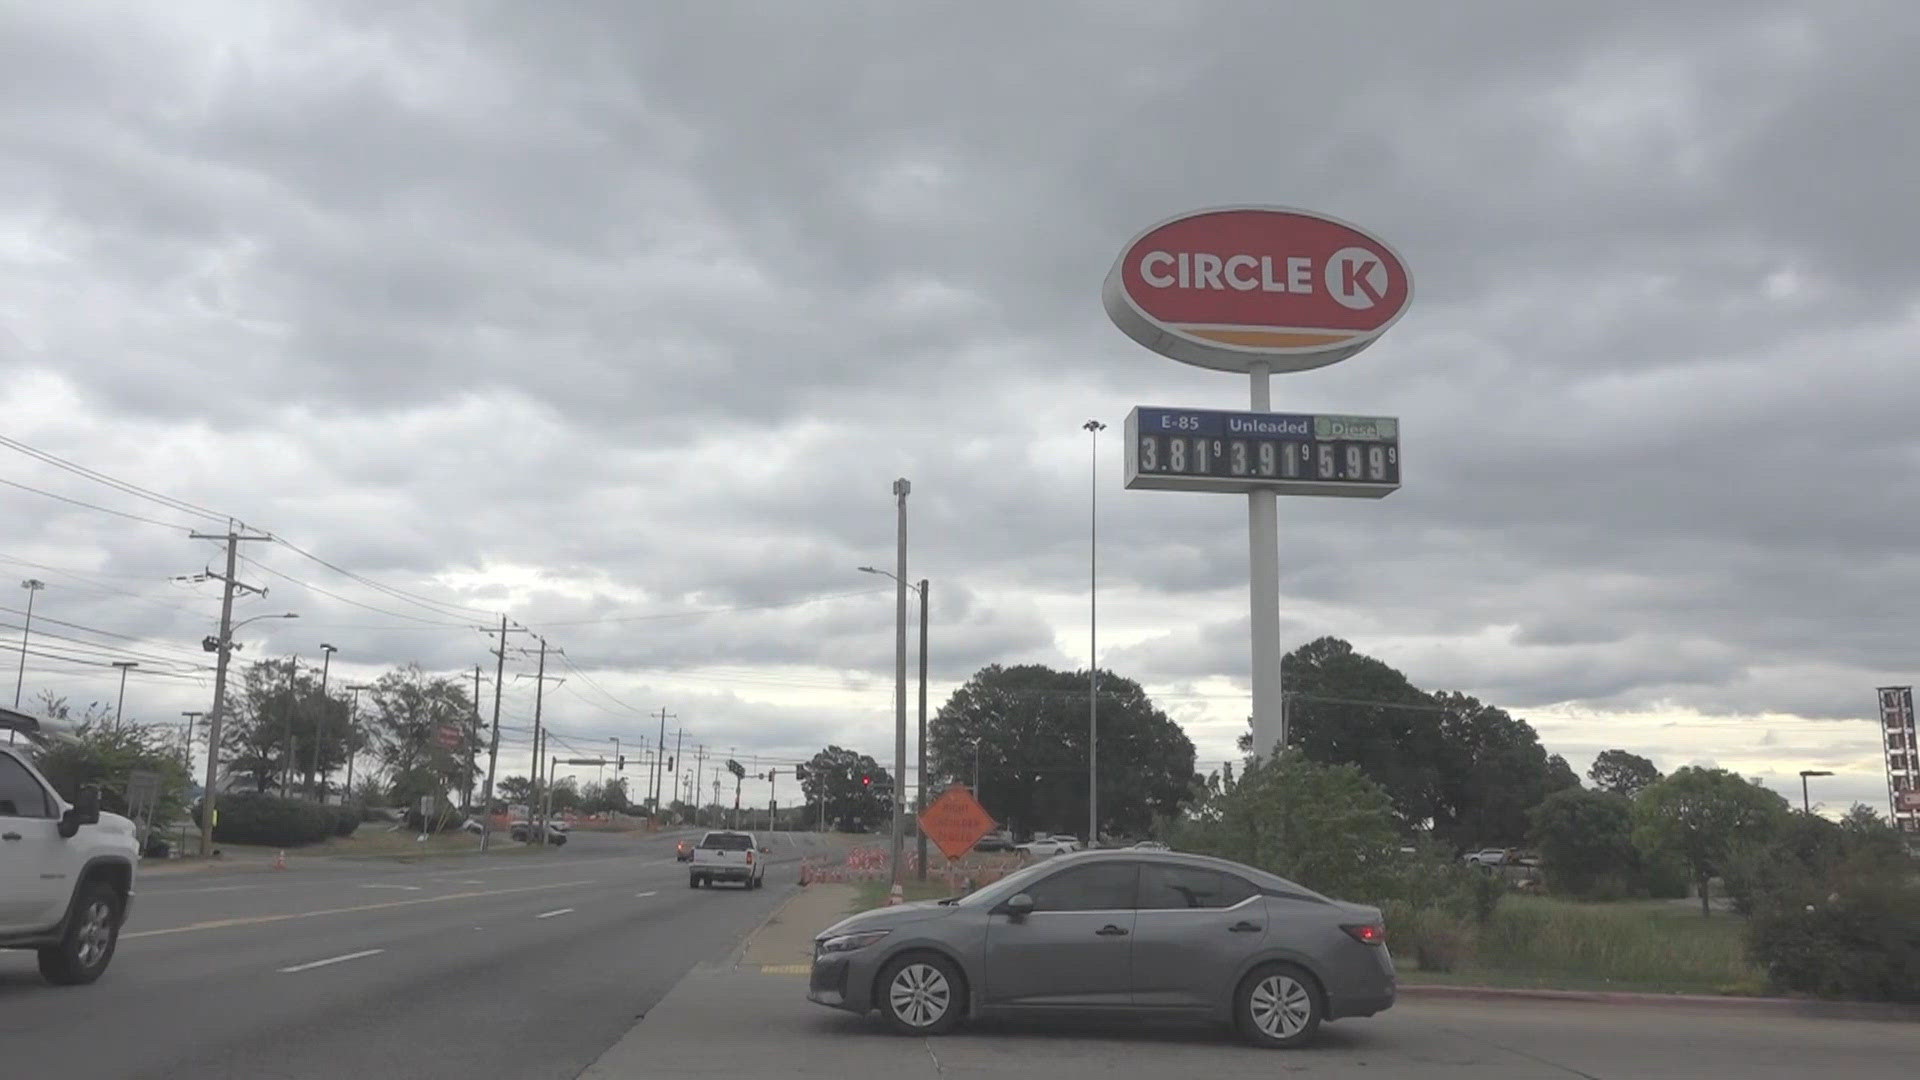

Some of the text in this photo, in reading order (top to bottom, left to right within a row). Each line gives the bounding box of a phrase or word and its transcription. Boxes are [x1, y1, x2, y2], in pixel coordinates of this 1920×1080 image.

[1140, 250, 1385, 307] CIRCLE K
[1161, 415, 1199, 430] E-85
[1229, 418, 1308, 434] Unleaded
